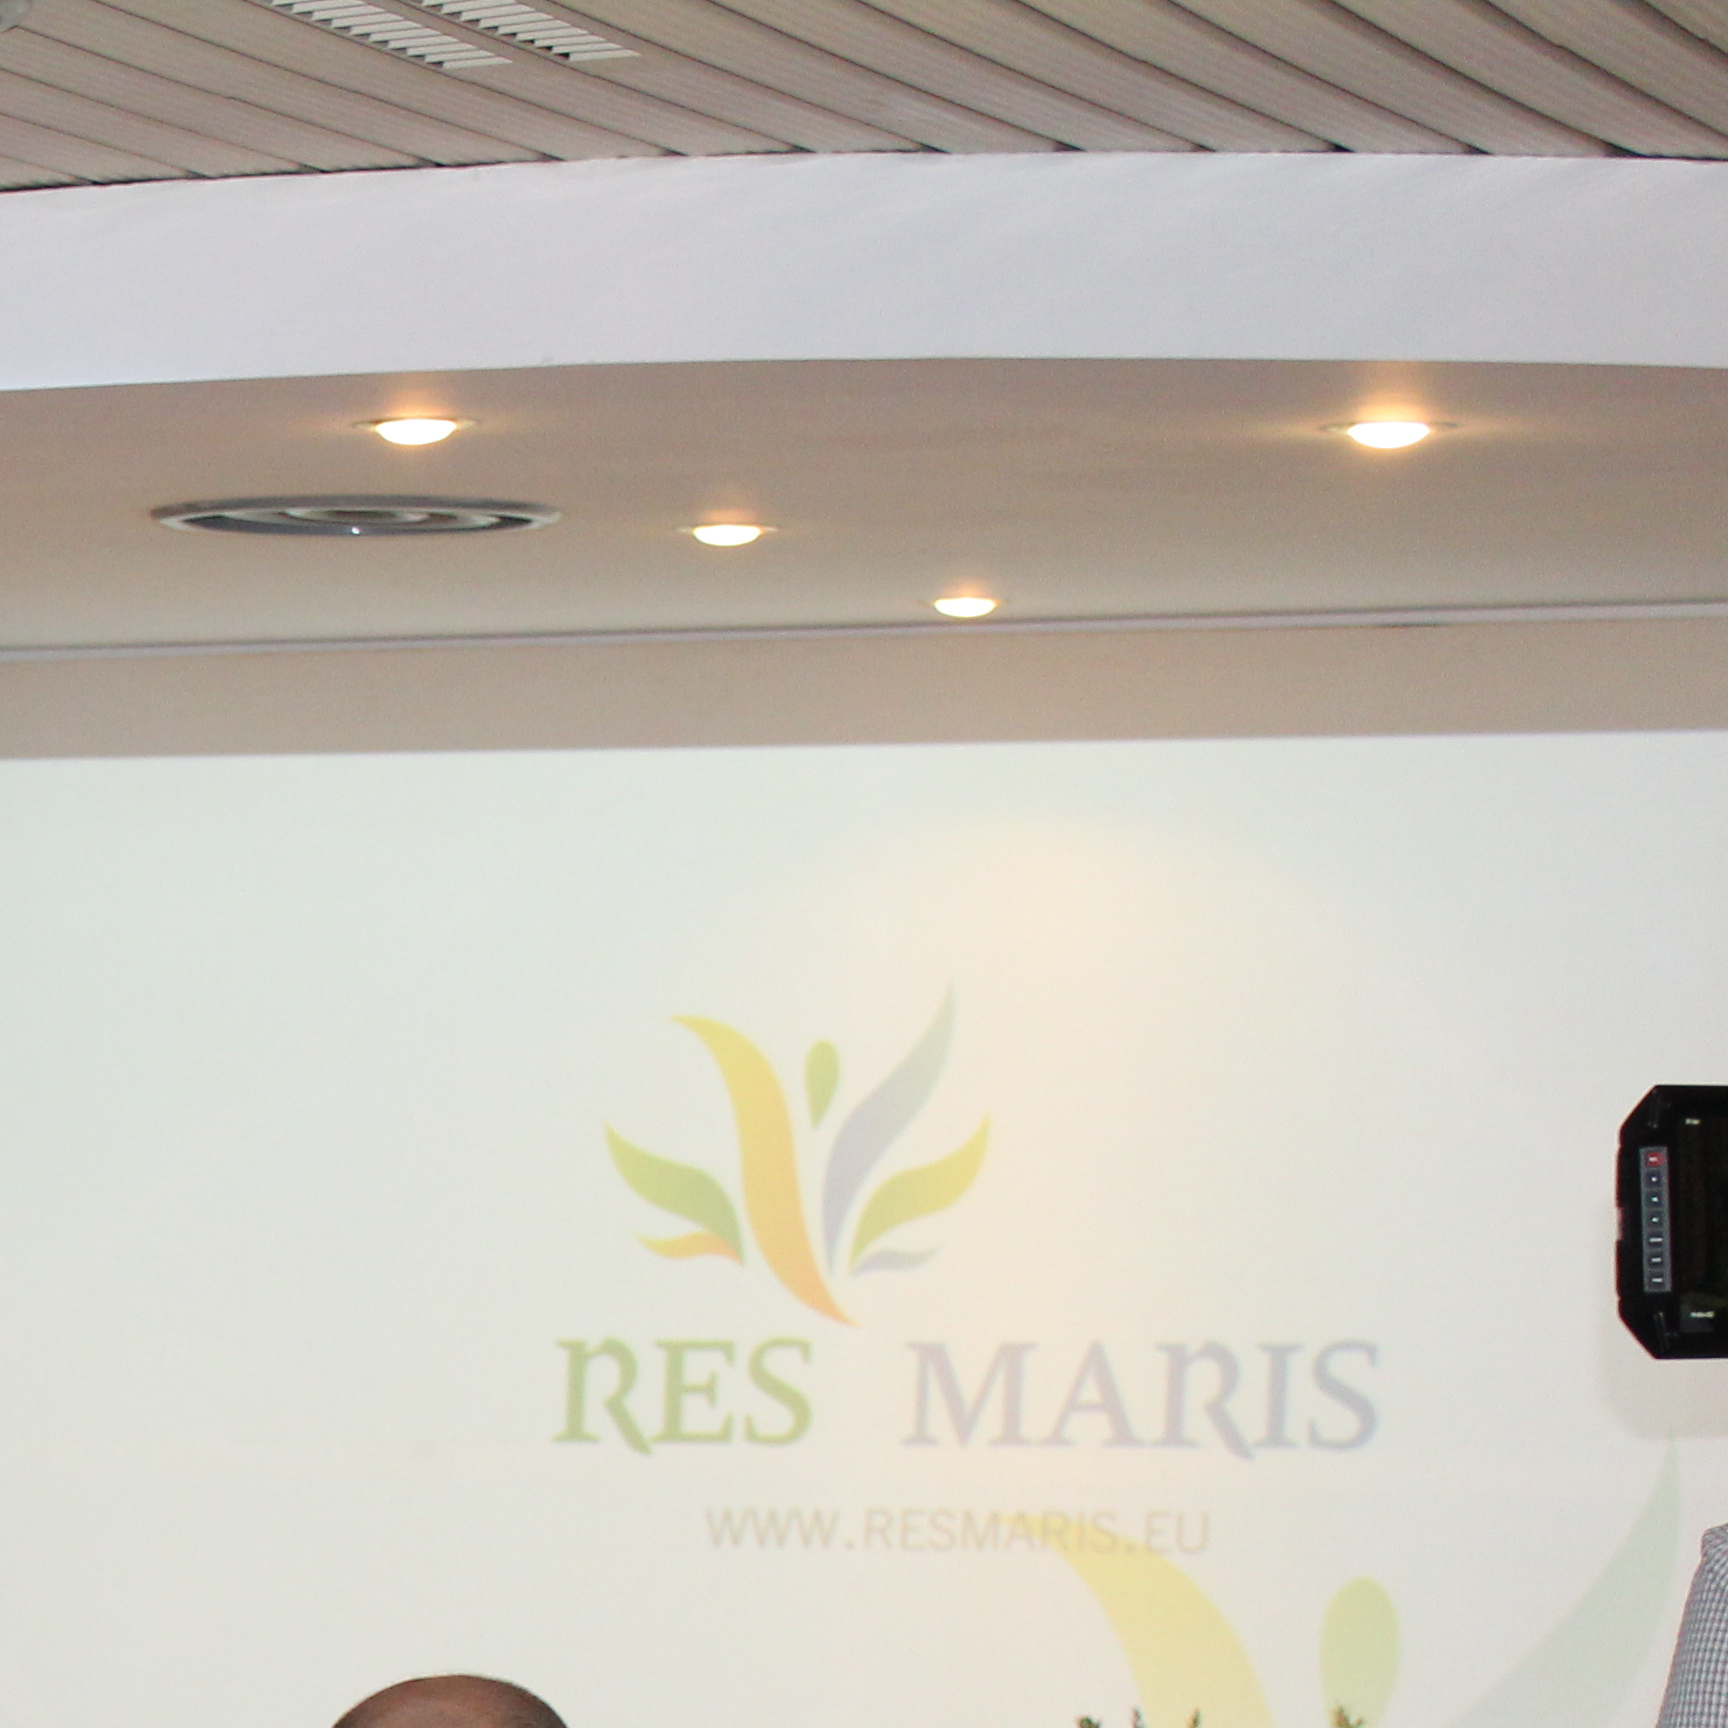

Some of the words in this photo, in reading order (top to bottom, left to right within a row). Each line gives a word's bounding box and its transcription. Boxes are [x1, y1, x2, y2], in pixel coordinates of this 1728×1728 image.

[551, 1335, 814, 1456] RES
[899, 1337, 1382, 1460] MARIS
[705, 1504, 1212, 1558] WWW.RESMARIS.EU
